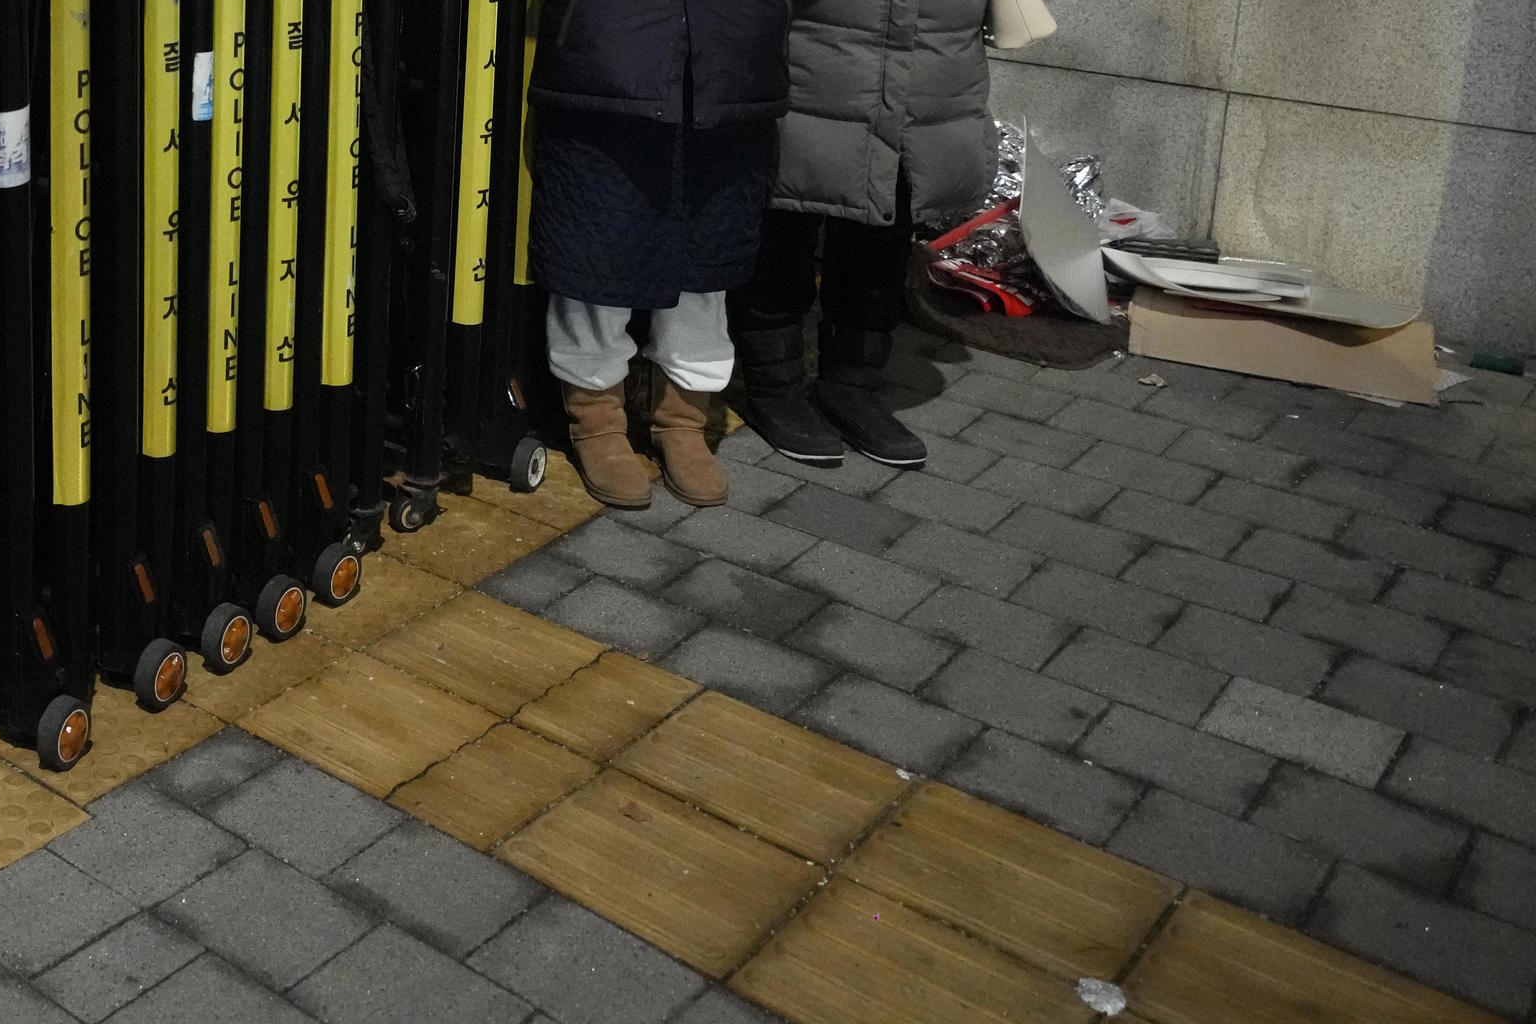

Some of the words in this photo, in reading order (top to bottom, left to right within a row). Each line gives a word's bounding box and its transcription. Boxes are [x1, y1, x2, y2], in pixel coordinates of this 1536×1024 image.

[74, 70, 91, 277] POLICE
[227, 32, 244, 222] POLICE
[78, 319, 91, 449] LINE
[223, 262, 239, 381] LINE
